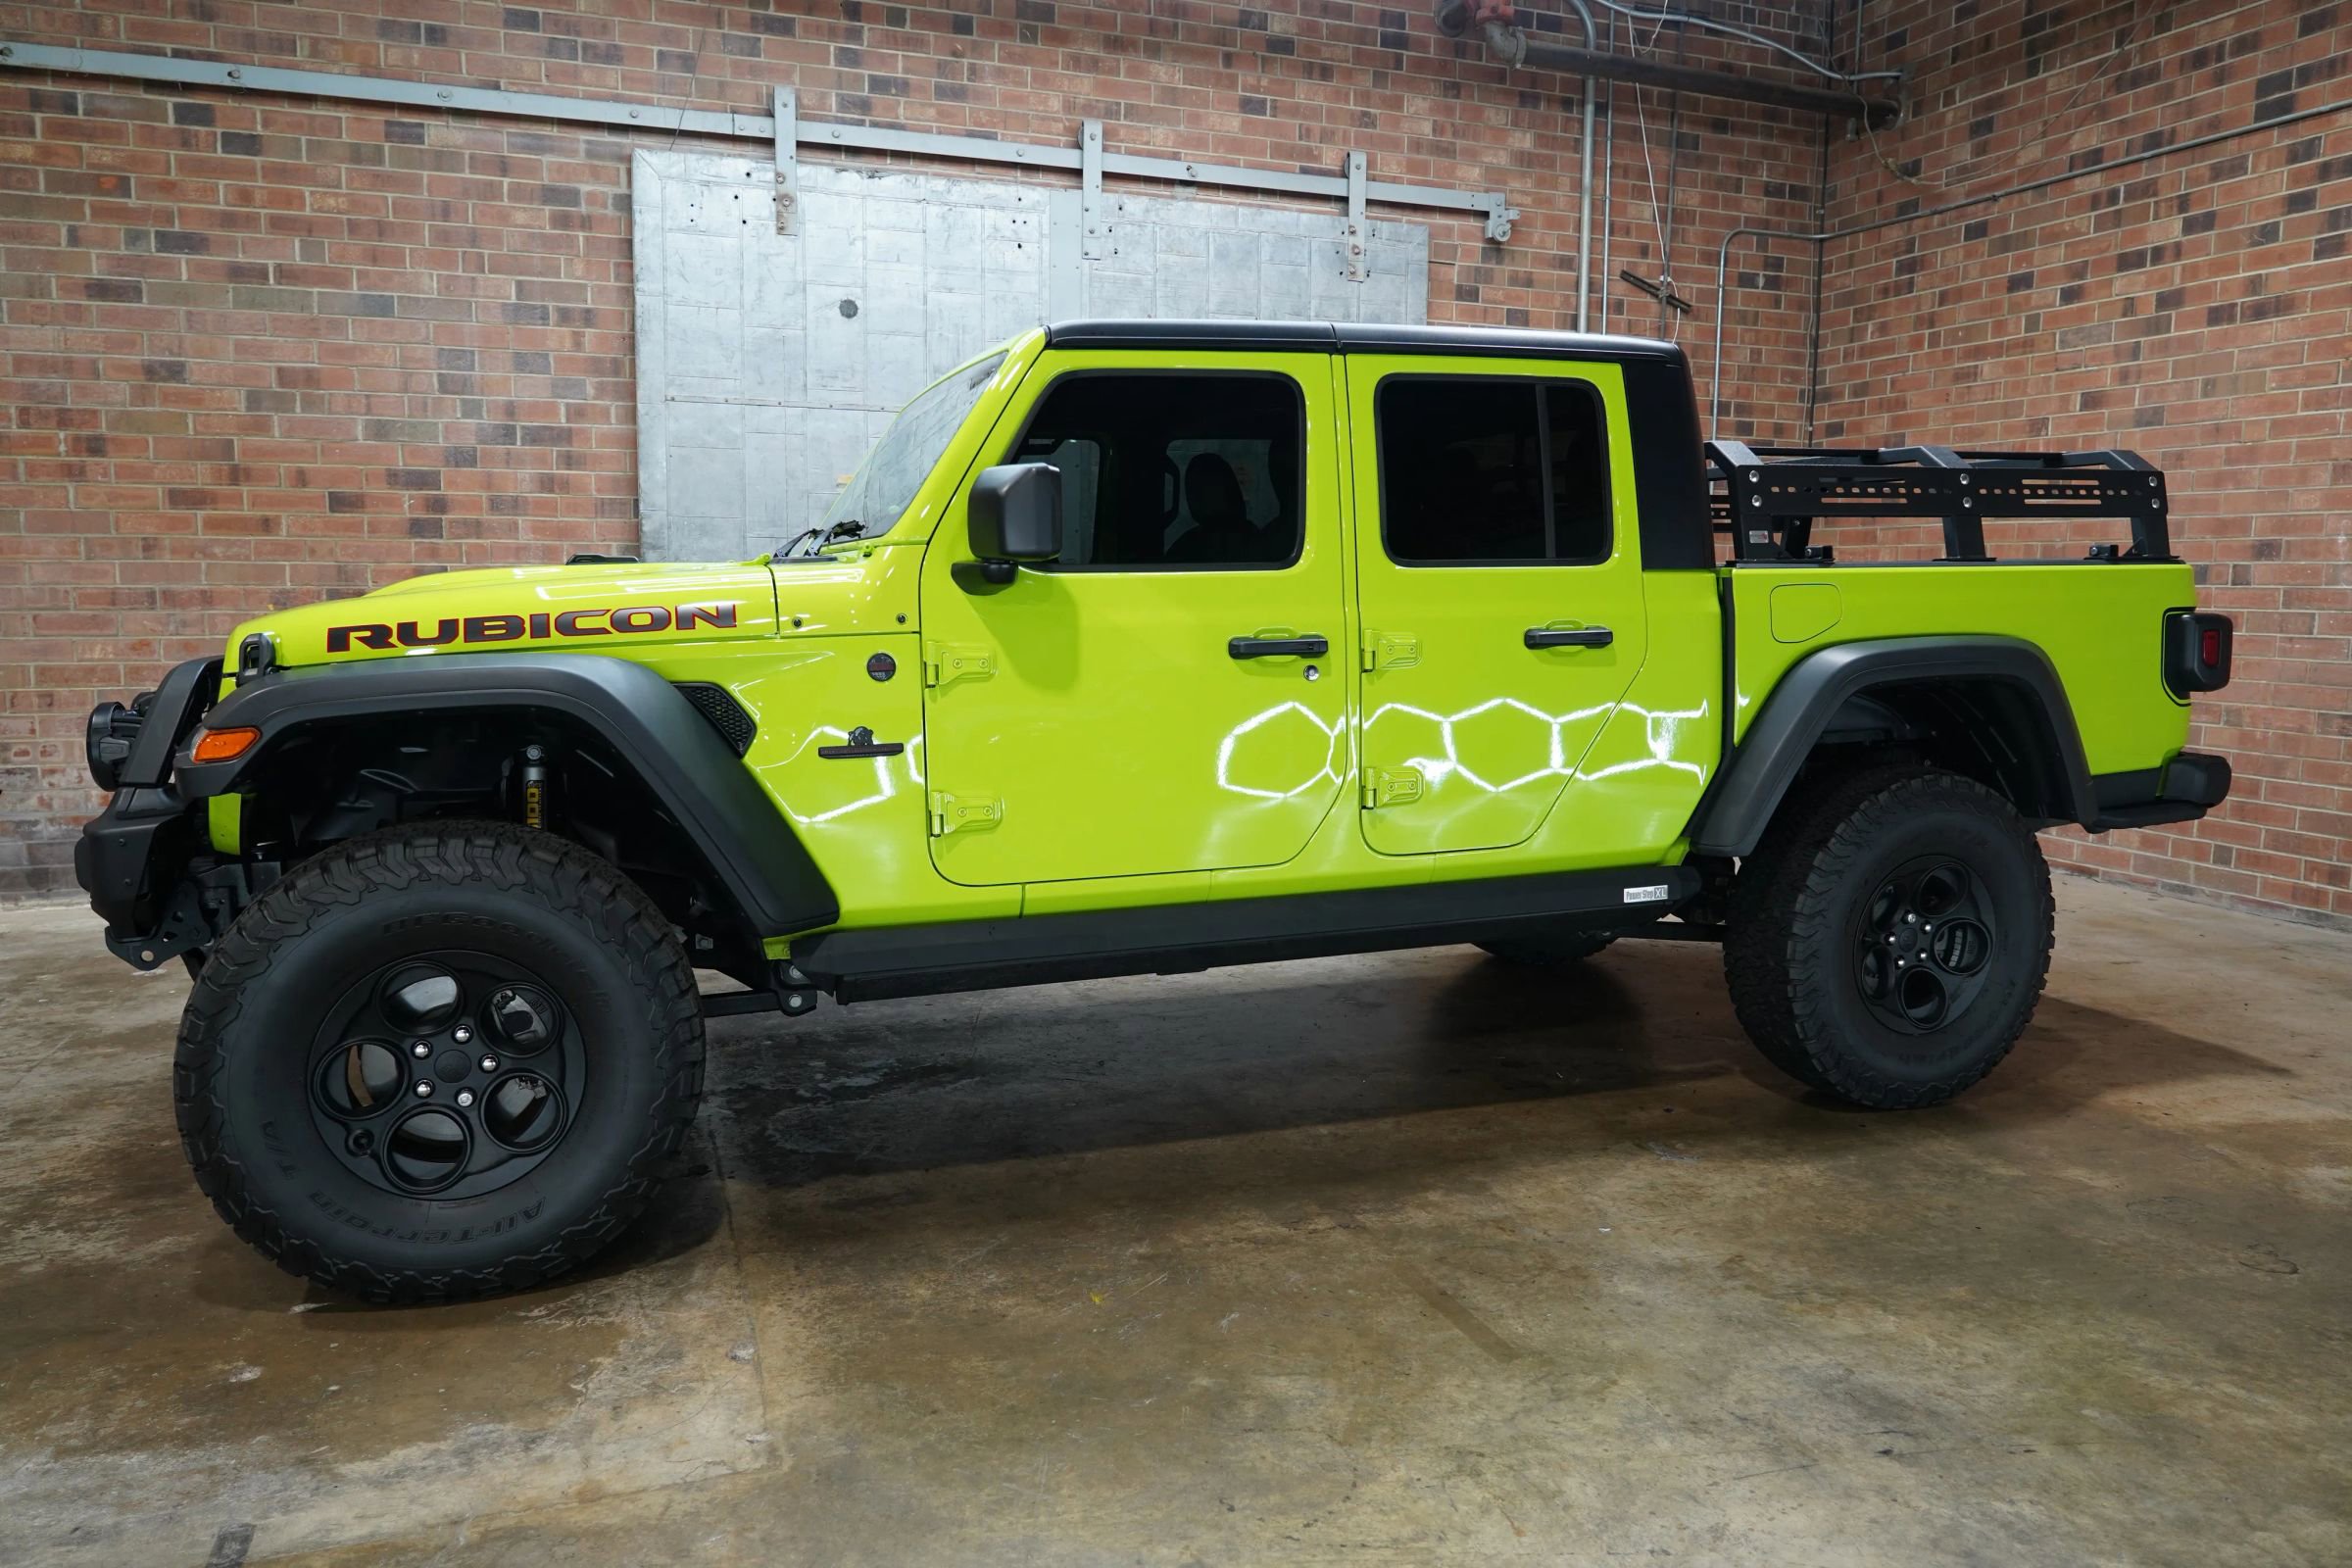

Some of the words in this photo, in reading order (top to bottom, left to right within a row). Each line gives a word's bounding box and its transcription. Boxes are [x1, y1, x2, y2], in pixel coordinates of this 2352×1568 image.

[326, 603, 737, 654] RUBICON
[1654, 887, 1667, 899] XL
[306, 1189, 547, 1246] All-Terrain
